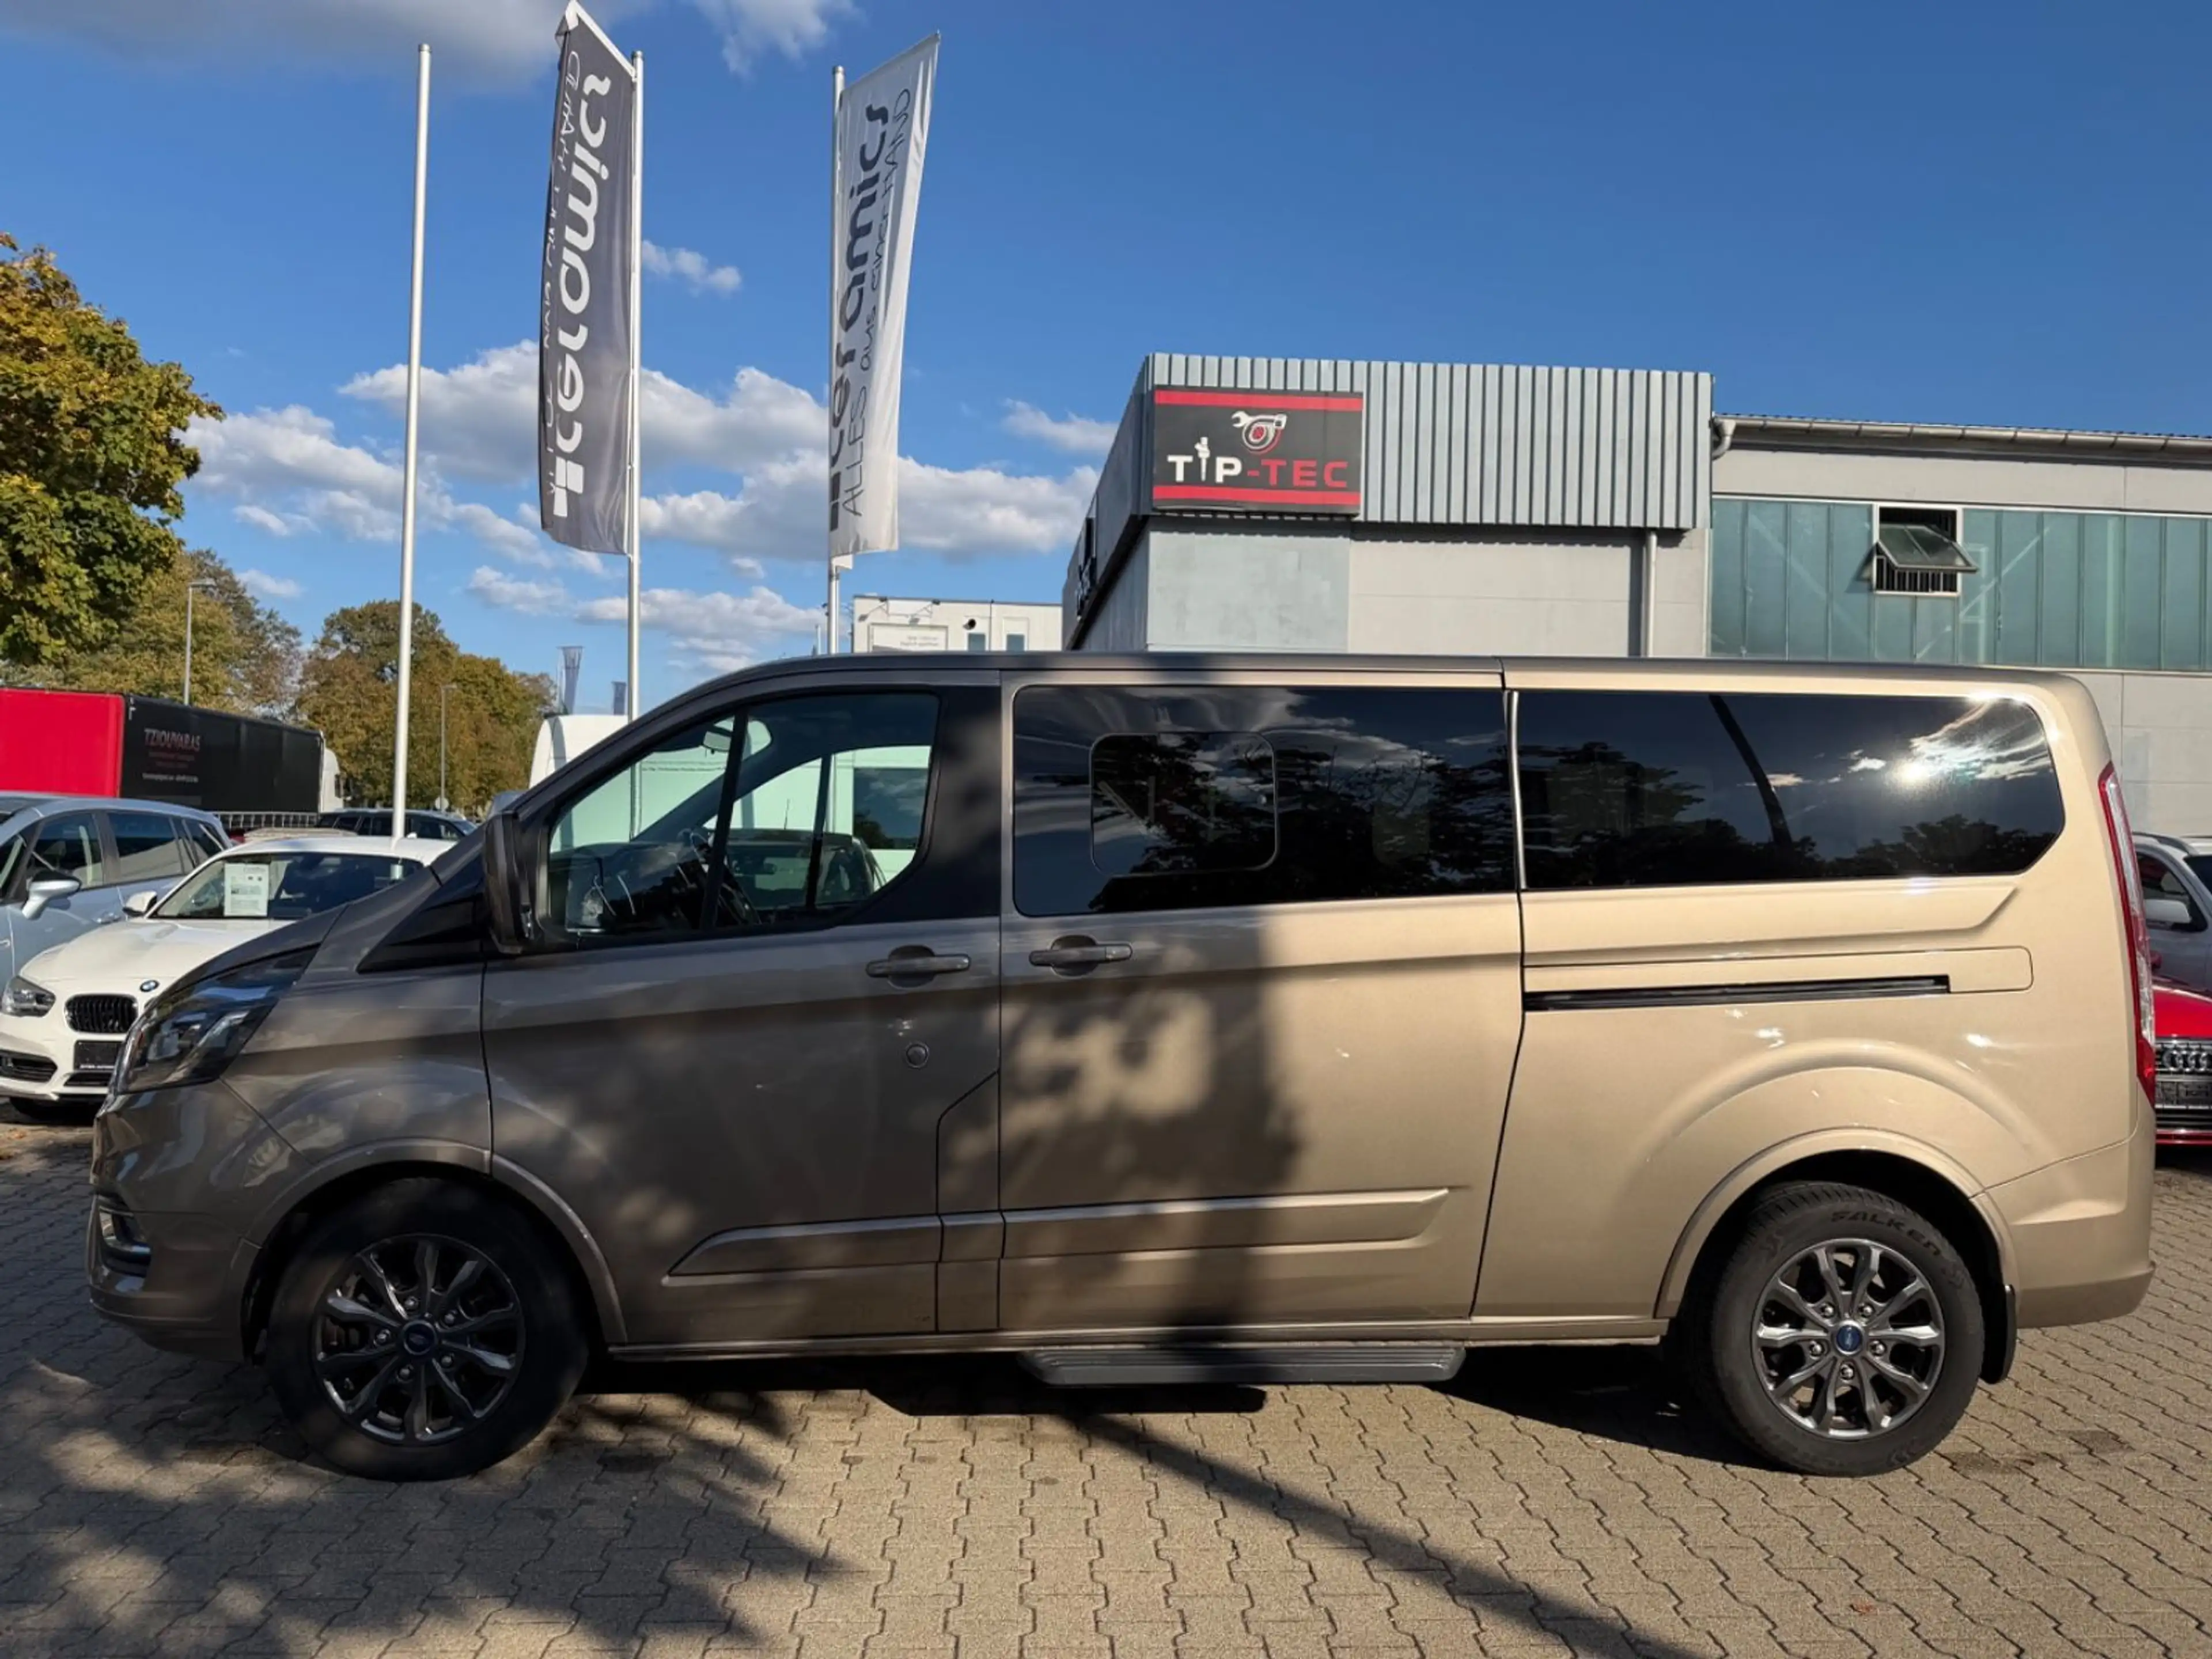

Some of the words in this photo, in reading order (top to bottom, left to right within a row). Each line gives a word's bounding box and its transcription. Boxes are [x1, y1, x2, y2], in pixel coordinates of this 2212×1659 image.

[842, 385, 867, 517] ALLES
[860, 305, 877, 370] aus
[881, 88, 911, 199] HAND
[1167, 436, 1349, 488] TIP-TEC
